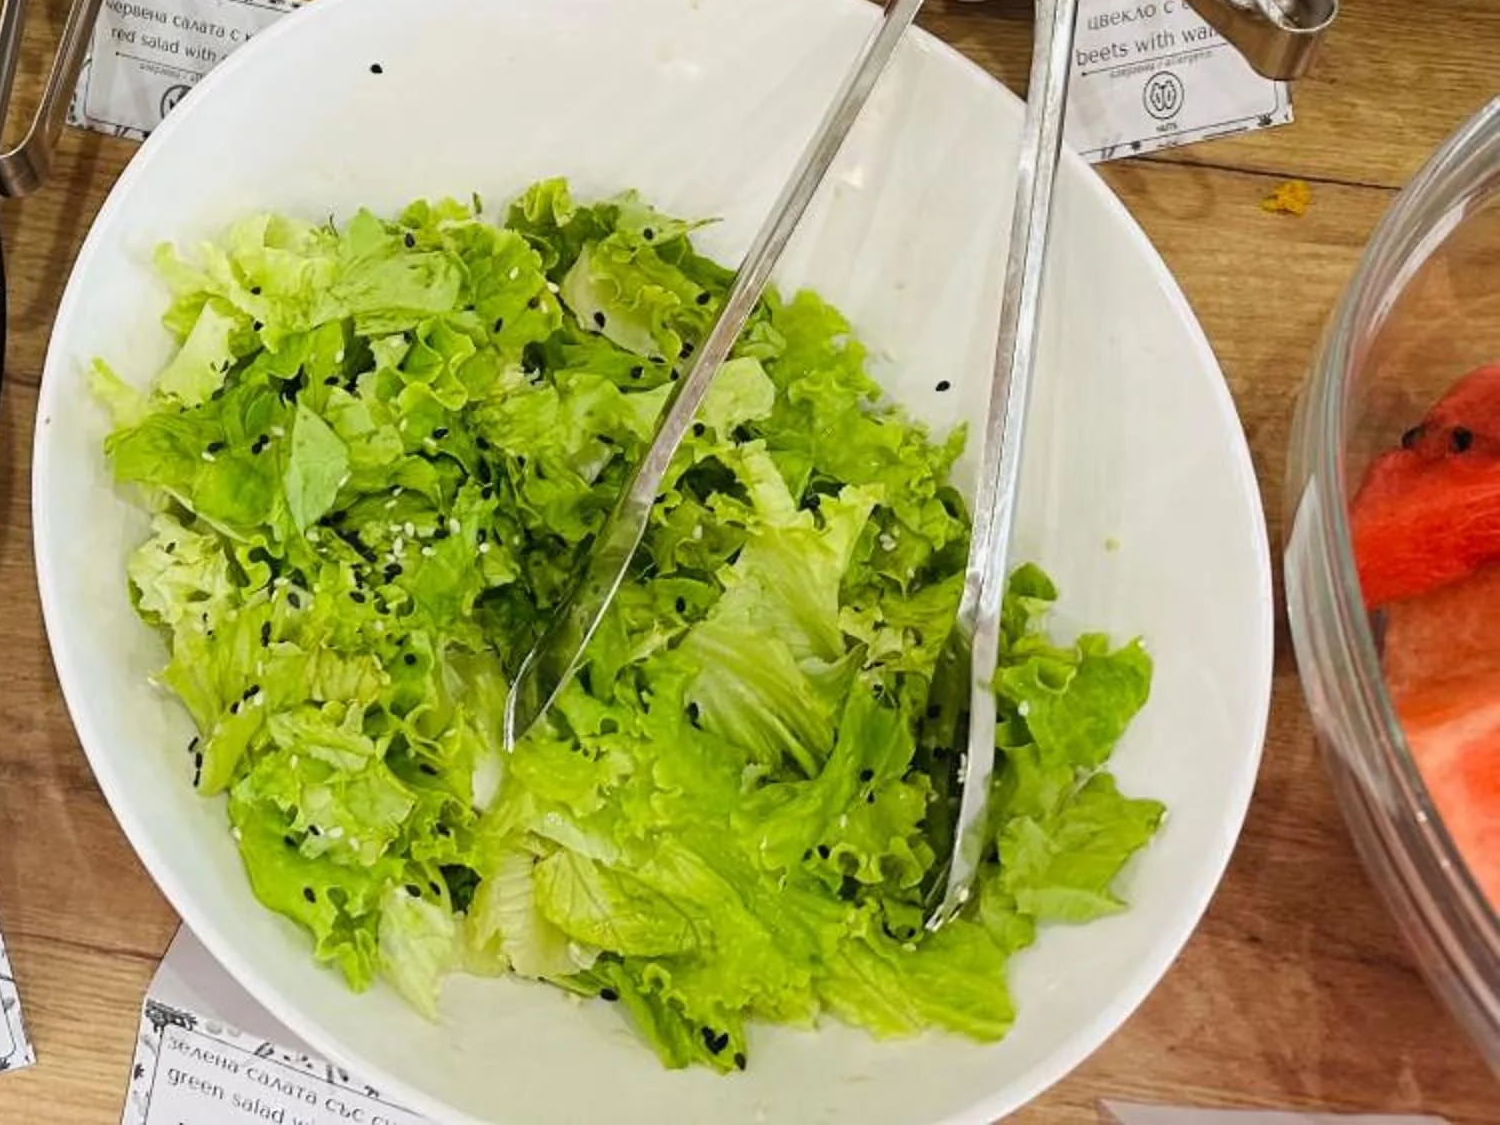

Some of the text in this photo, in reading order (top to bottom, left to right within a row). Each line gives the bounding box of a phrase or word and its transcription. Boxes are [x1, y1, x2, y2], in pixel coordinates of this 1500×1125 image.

[172, 14, 225, 38] салата
[230, 29, 240, 41] с
[1087, 0, 1175, 30] цвекло с
[111, 26, 217, 63] red salad with
[1075, 42, 1128, 66] beets
[1135, 29, 1175, 53] with
[167, 1036, 364, 1121] зелена салата със
[167, 1067, 285, 1124] green salad
